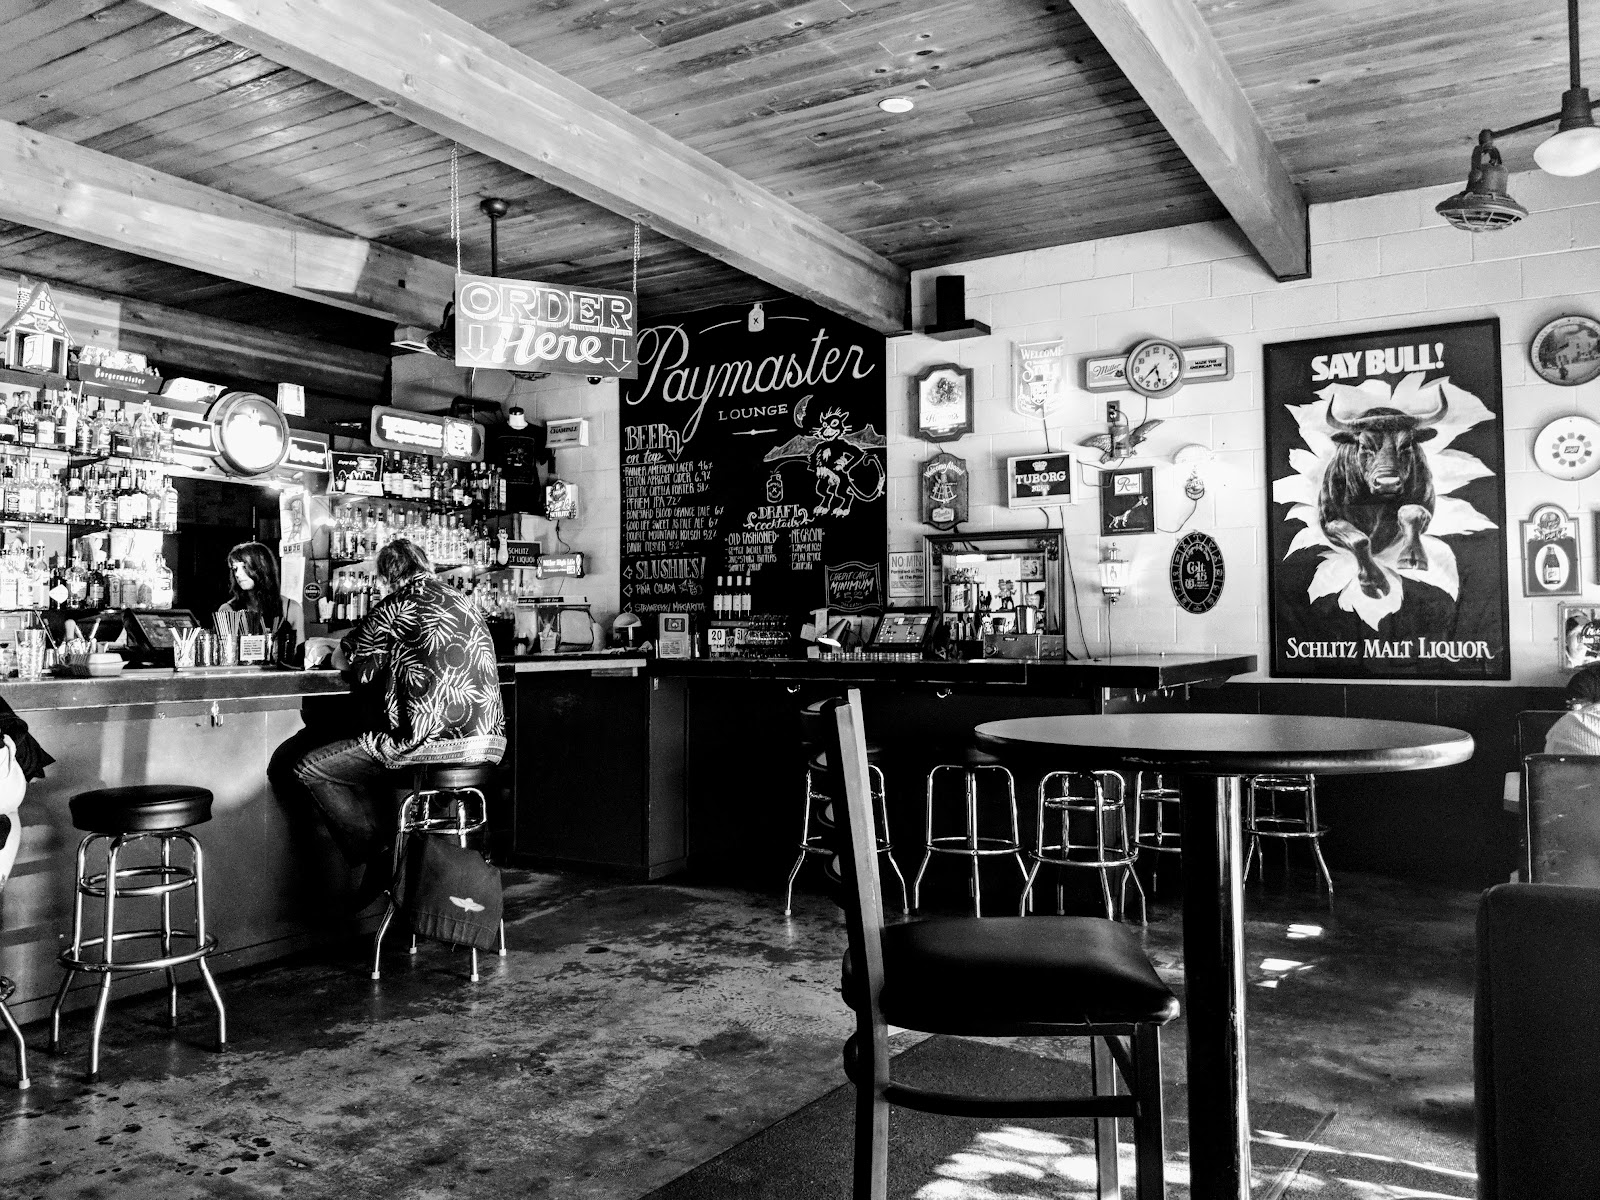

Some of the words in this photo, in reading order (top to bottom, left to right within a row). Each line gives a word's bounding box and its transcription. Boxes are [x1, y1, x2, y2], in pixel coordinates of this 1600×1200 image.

[460, 281, 633, 336] ORDER
[491, 323, 604, 365] Here
[1020, 346, 1063, 360] WELCOME
[1311, 351, 1362, 381] SAY
[1365, 342, 1445, 376] BULL!
[1093, 364, 1122, 376] Miller
[1135, 366, 1140, 374] 9
[626, 323, 875, 443] Paymaster
[718, 404, 788, 421] LOUNGE
[624, 424, 670, 451] BEER
[626, 454, 640, 464] on
[643, 450, 664, 466] tap
[676, 461, 694, 473] LAGER
[673, 472, 692, 484] CIDER
[1015, 471, 1066, 484] TUBORG
[653, 496, 666, 509] IPA
[758, 504, 800, 519] DRAFT
[728, 532, 741, 545] OLD
[742, 530, 777, 545] FASHIONED
[508, 547, 530, 555] SCHLITZ
[635, 556, 706, 579] SLUSHIES!
[891, 556, 904, 567] NO
[1186, 561, 1206, 574] Colt
[653, 582, 677, 595] COLADA
[829, 577, 875, 595] MINIMUM
[711, 630, 722, 641] 20
[1286, 637, 1358, 659] SCHLITZ
[1363, 637, 1414, 659] MALT
[1417, 636, 1495, 662] LIQUOR
